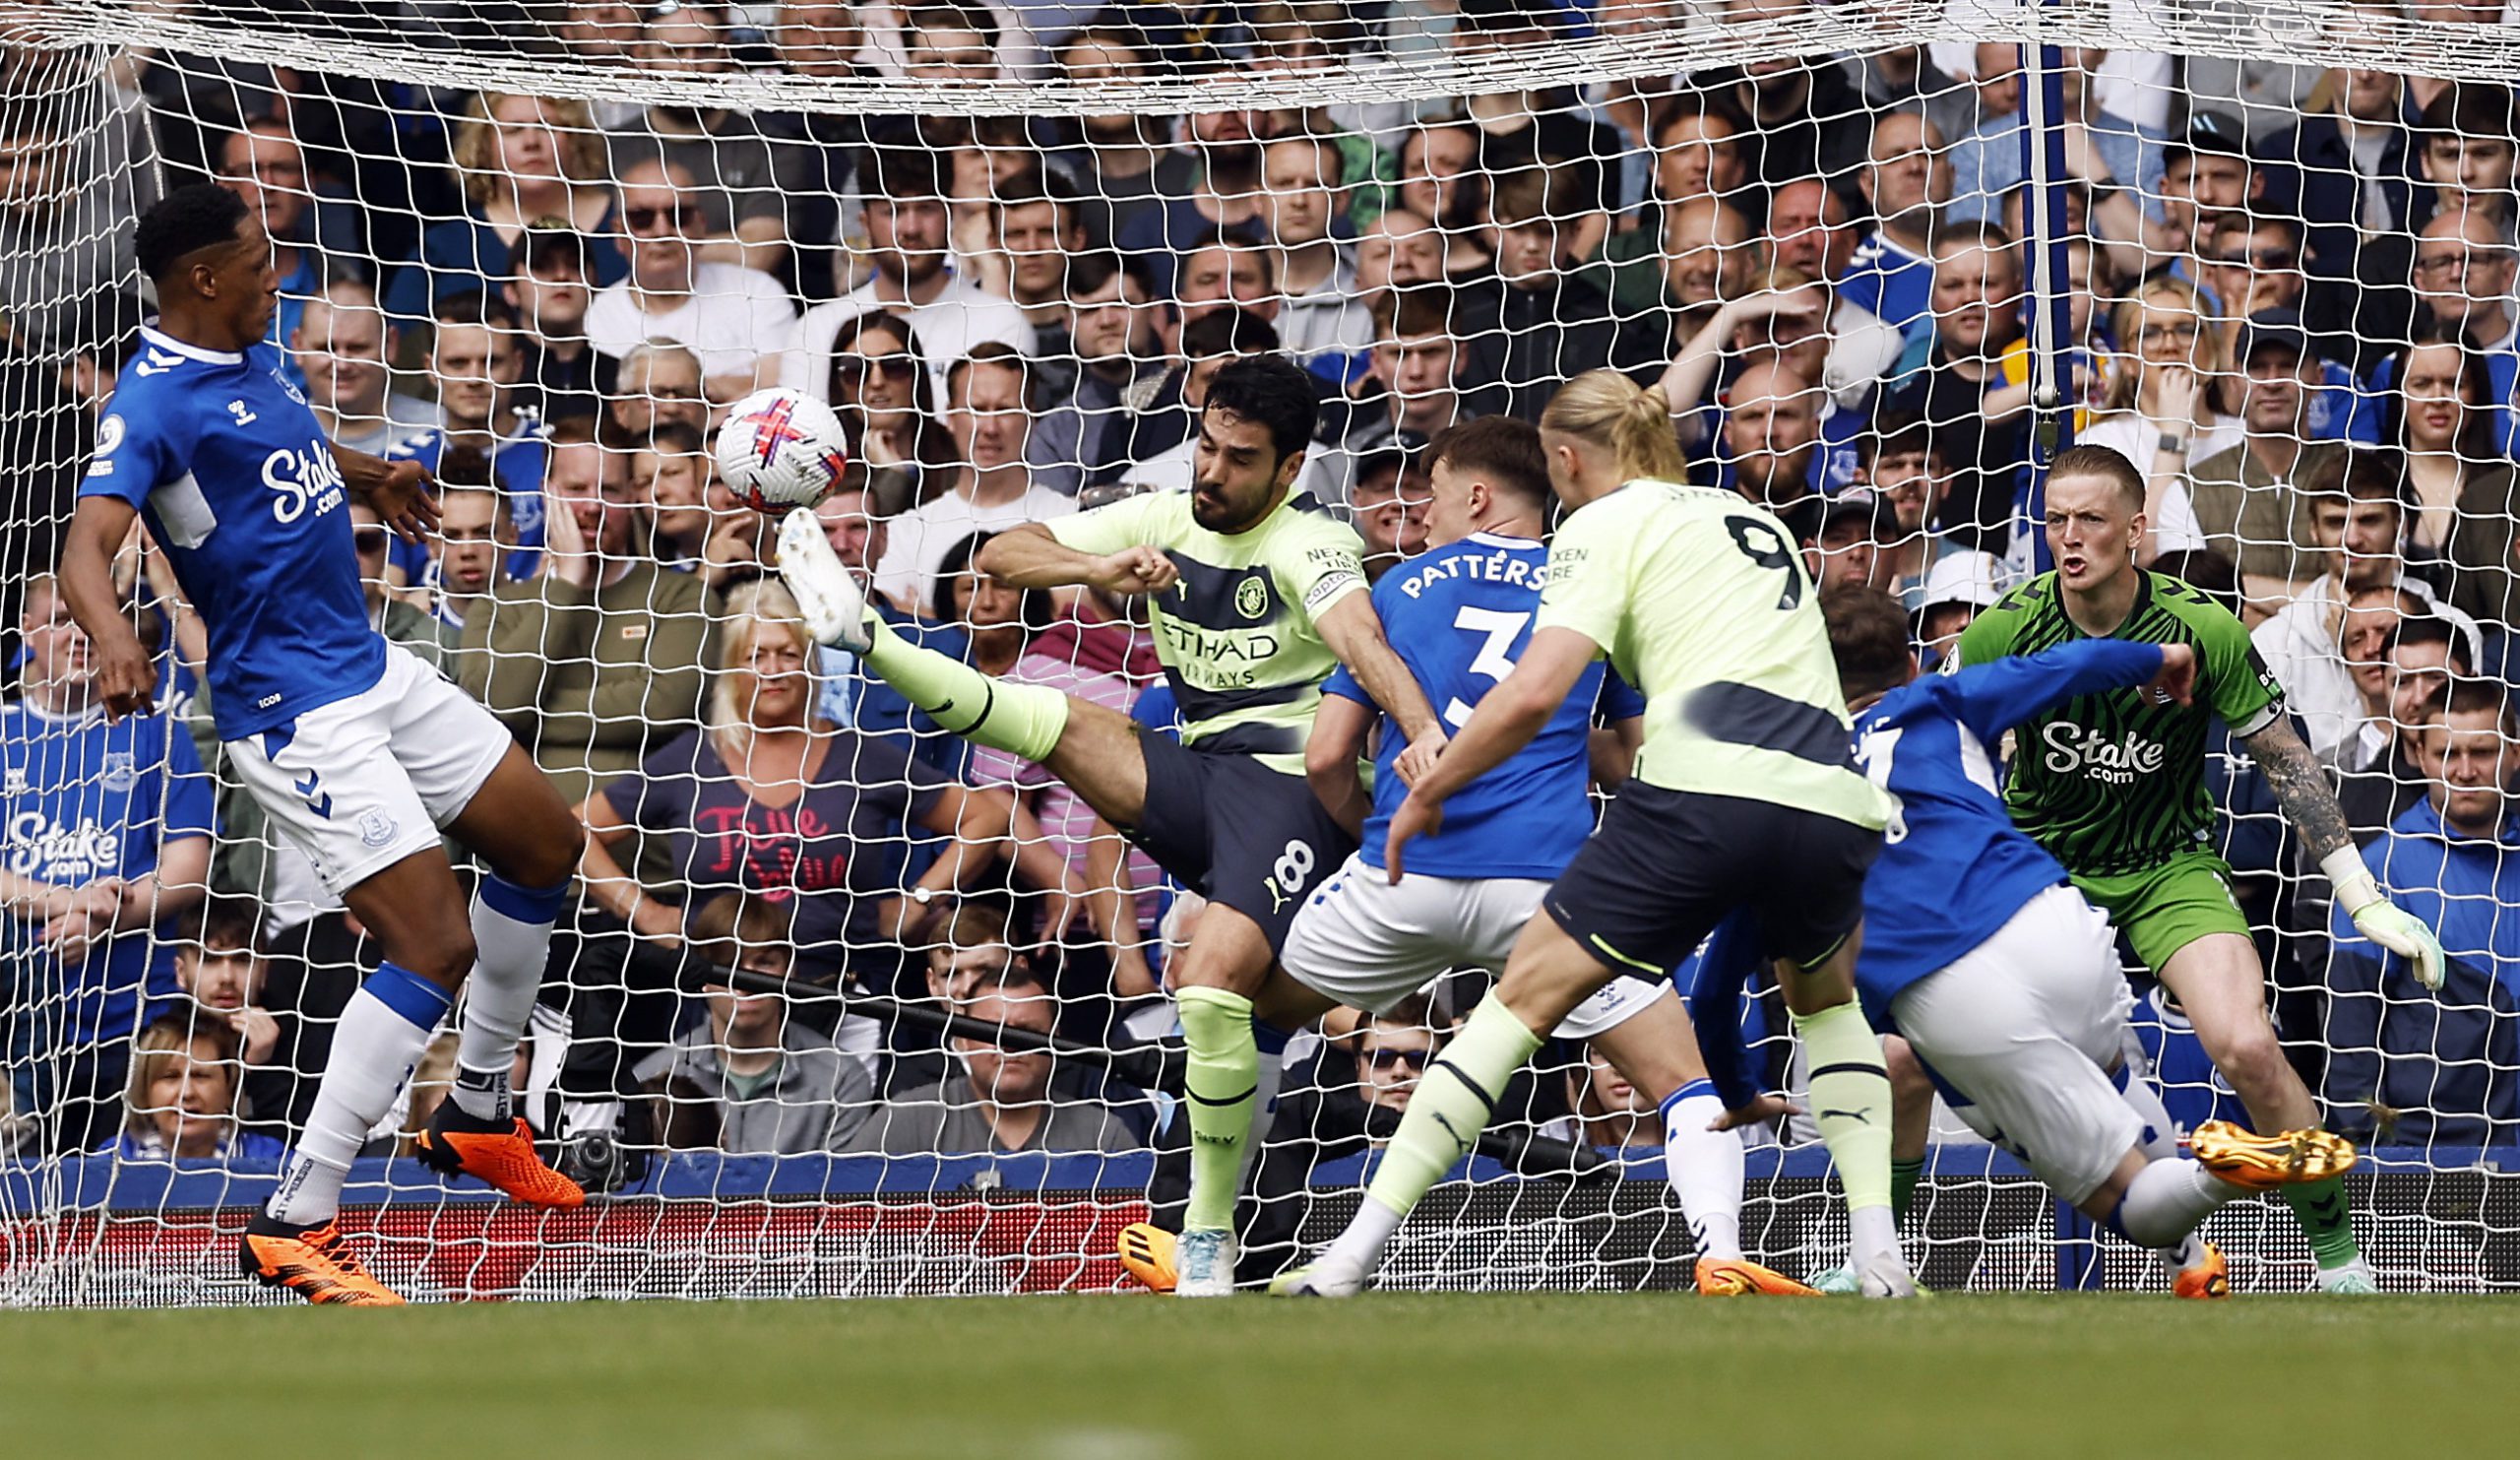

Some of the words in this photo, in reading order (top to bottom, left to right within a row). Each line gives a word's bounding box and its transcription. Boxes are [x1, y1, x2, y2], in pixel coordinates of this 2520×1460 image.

[262, 439, 345, 524] Stake
[315, 488, 344, 517] .com
[1401, 554, 1547, 599] PATTERS
[1725, 516, 1800, 609] 9
[1443, 605, 1531, 728] 3
[2043, 721, 2165, 773] Stake
[2083, 767, 2134, 785] .com
[10, 810, 118, 874] Stake
[697, 805, 829, 873] True
[1274, 839, 1315, 893] 8
[41, 860, 90, 879] .com
